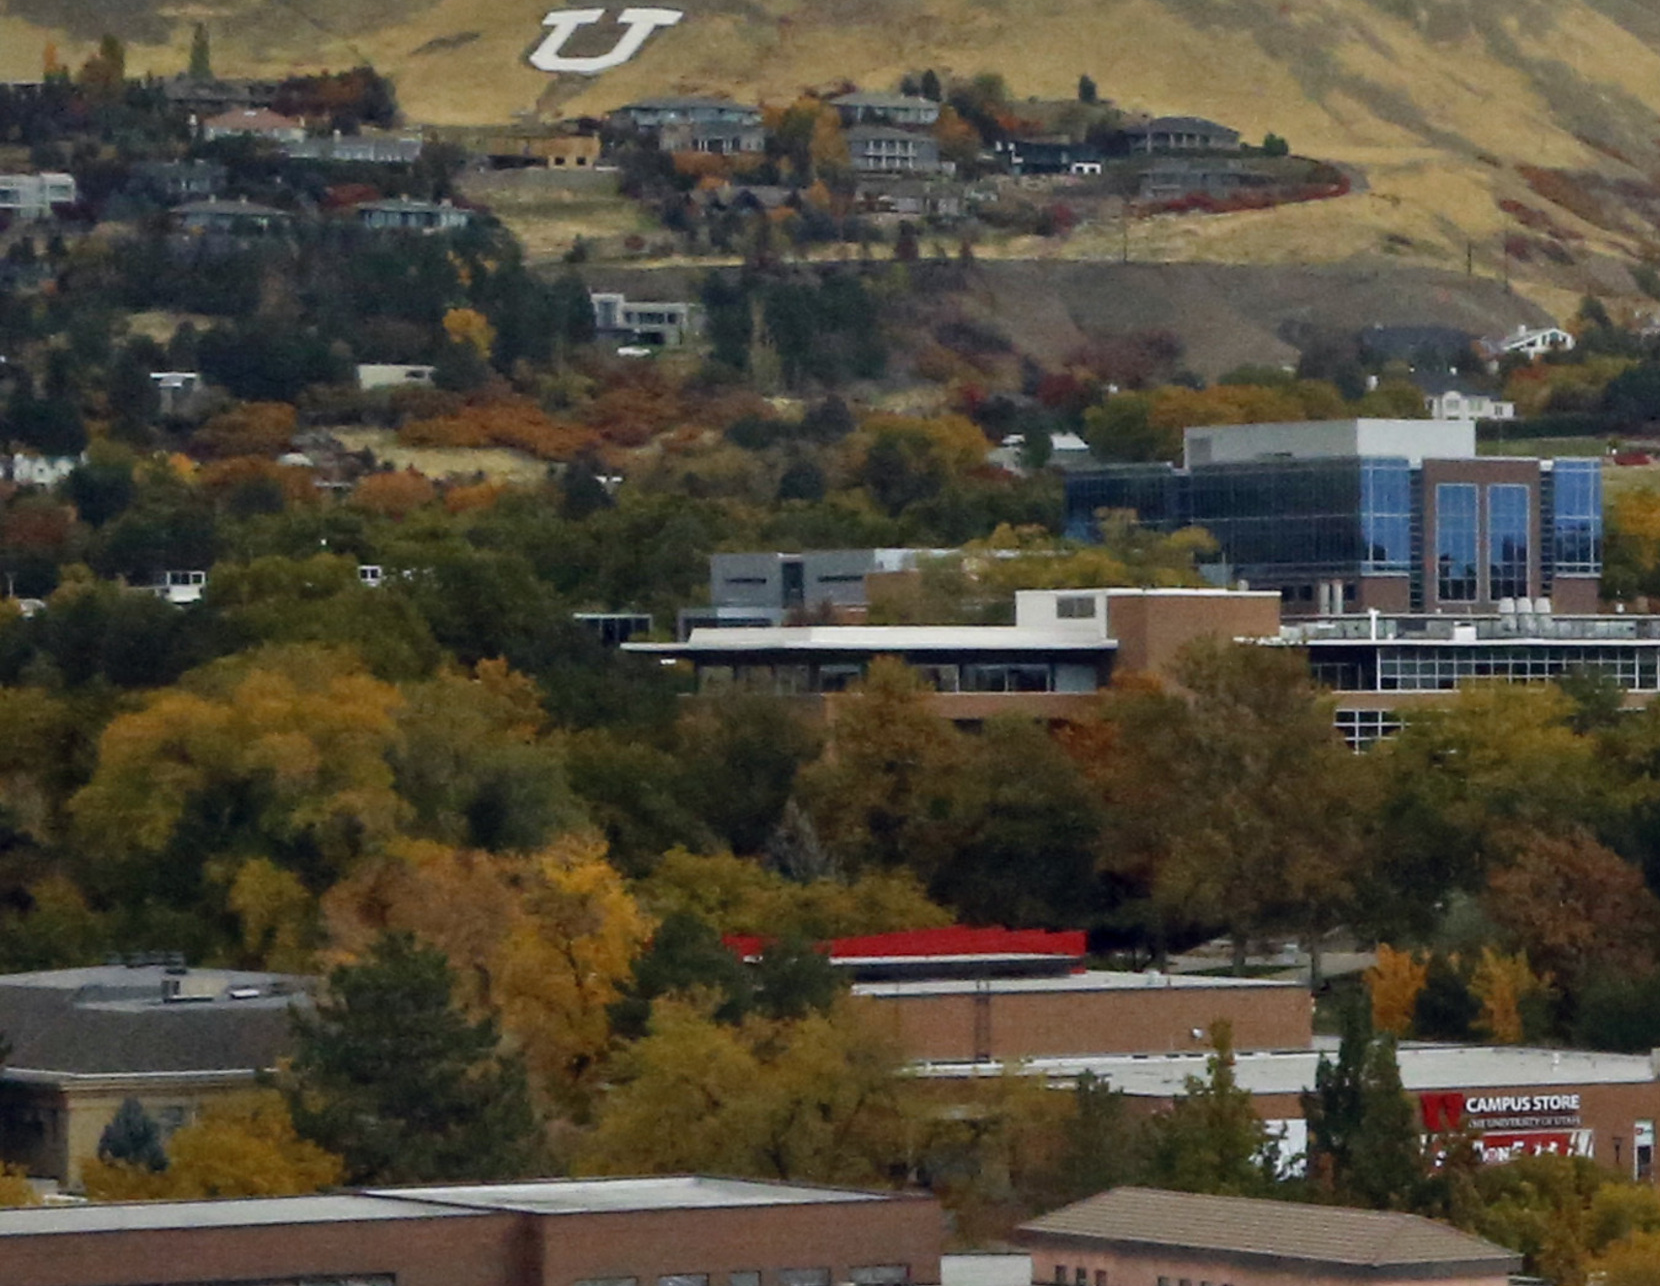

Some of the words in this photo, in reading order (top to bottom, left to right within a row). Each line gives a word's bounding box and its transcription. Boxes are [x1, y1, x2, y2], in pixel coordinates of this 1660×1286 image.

[529, 8, 684, 74] U
[1466, 1096, 1531, 1113] CAMPUS
[1533, 1094, 1580, 1110] STORE
